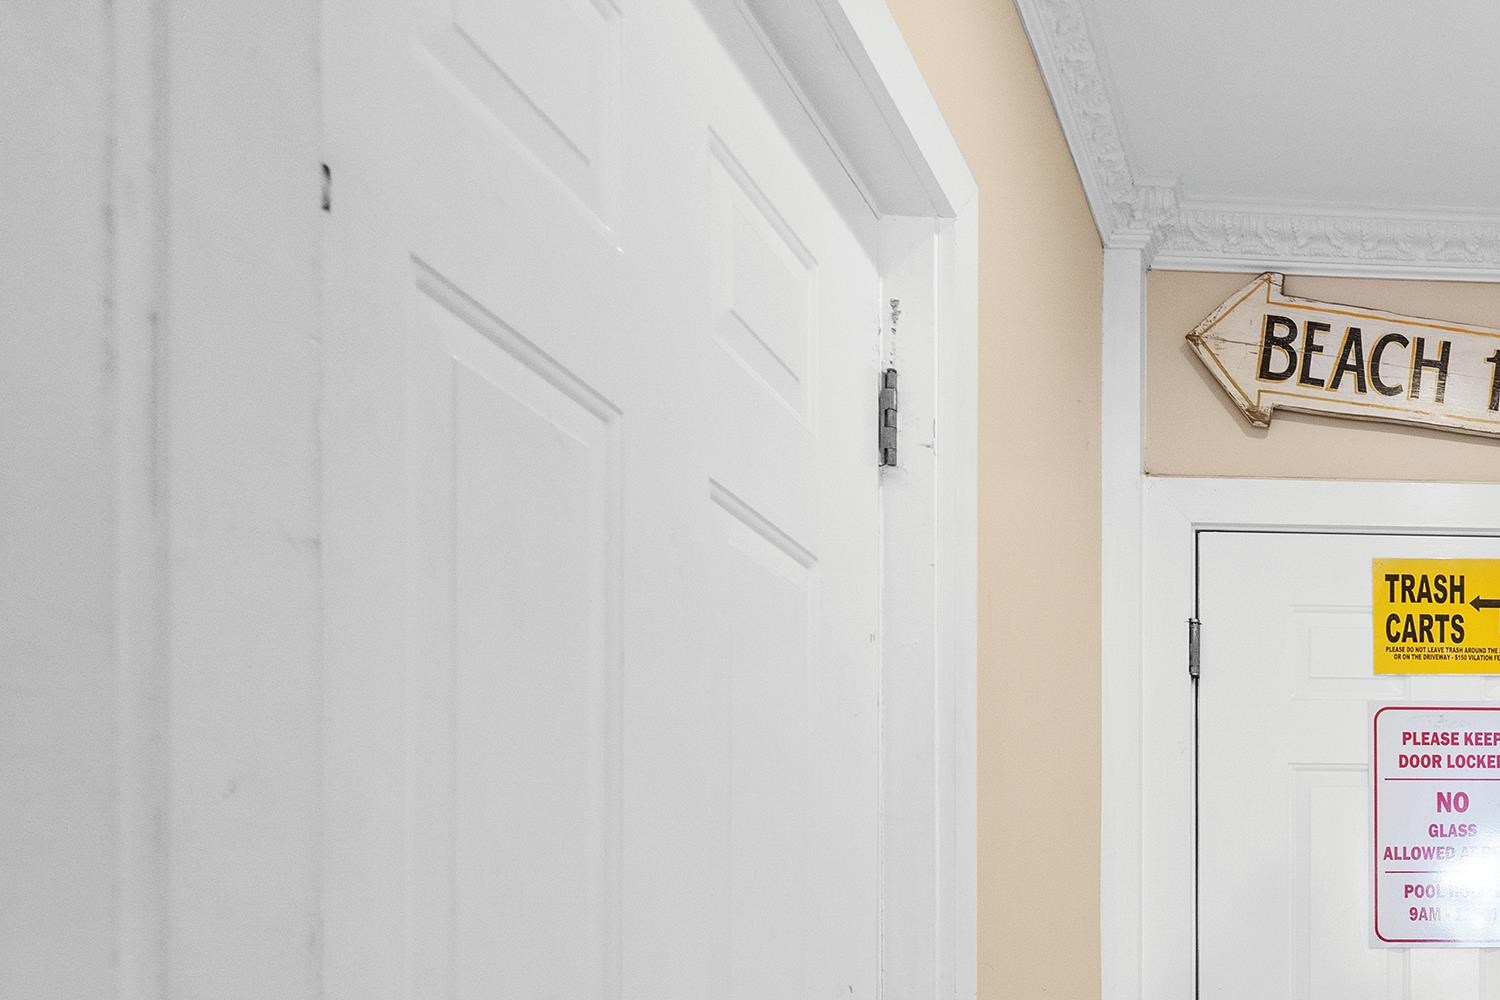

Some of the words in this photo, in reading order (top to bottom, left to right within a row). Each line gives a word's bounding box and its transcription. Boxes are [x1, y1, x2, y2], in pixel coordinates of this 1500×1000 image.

[1256, 313, 1452, 403] BEACH
[1385, 573, 1465, 604] TRASH
[1385, 613, 1465, 644] CARTS
[1402, 731, 1460, 746] PLEASE
[1399, 754, 1442, 769] DOOR
[1436, 791, 1470, 813] NO
[1428, 823, 1478, 838] GLASS
[1383, 846, 1455, 861] ALLOWED
